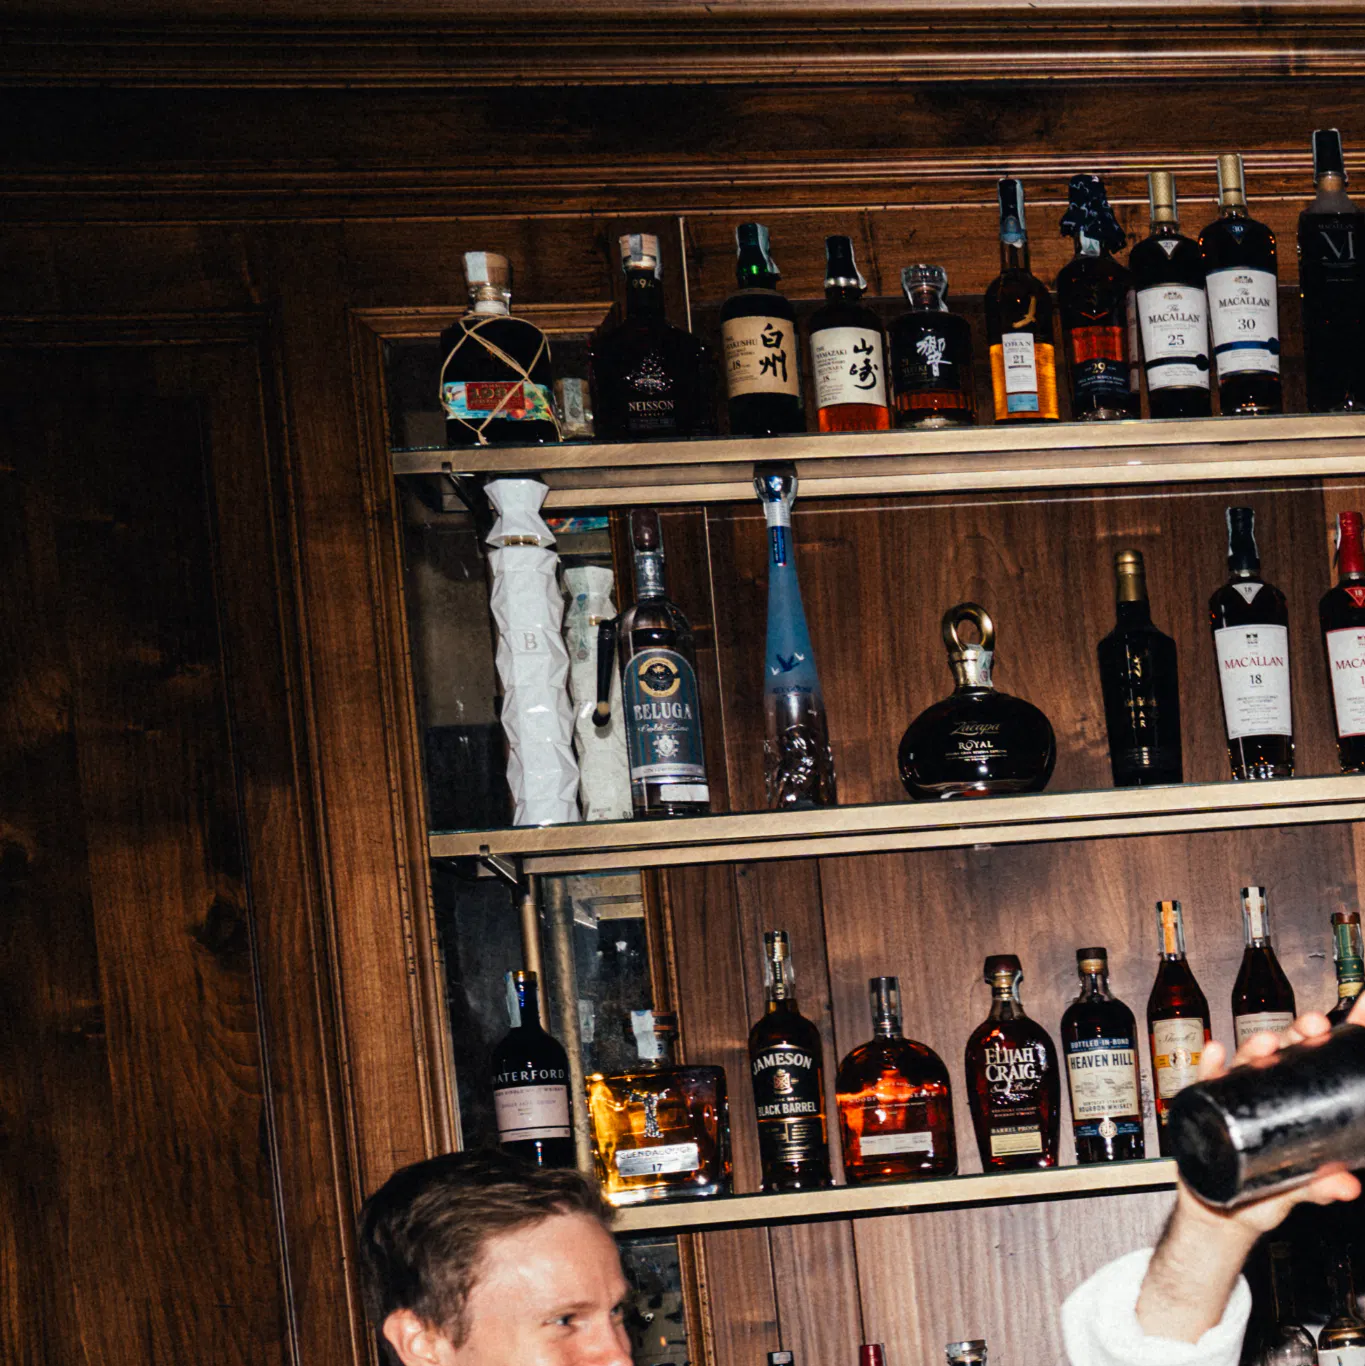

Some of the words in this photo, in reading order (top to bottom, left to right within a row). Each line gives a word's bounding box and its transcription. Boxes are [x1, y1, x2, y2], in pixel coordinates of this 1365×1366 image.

[1219, 297, 1271, 308] MACALLAN
[1149, 313, 1200, 324] MACALLAN
[1237, 318, 1256, 330] 30
[1168, 334, 1185, 347] 25
[1013, 355, 1025, 364] 21
[1092, 361, 1106, 373] 29
[628, 400, 675, 412] NEISSON
[1224, 656, 1284, 670] MACALLAN
[1250, 674, 1262, 685] 18
[633, 702, 692, 720] BELUGA
[949, 721, 1001, 736] Zacapa
[958, 740, 994, 751] ROYAL
[984, 1047, 1035, 1066] ELIJAH
[1070, 1053, 1109, 1070] HEAVEN
[1112, 1053, 1134, 1066] HILL
[752, 1052, 813, 1076] JAMESON
[985, 1063, 1036, 1083] CRAIG
[757, 1102, 780, 1117] BLACK
[782, 1101, 817, 1115] BARREL
[652, 1163, 662, 1172] 17
